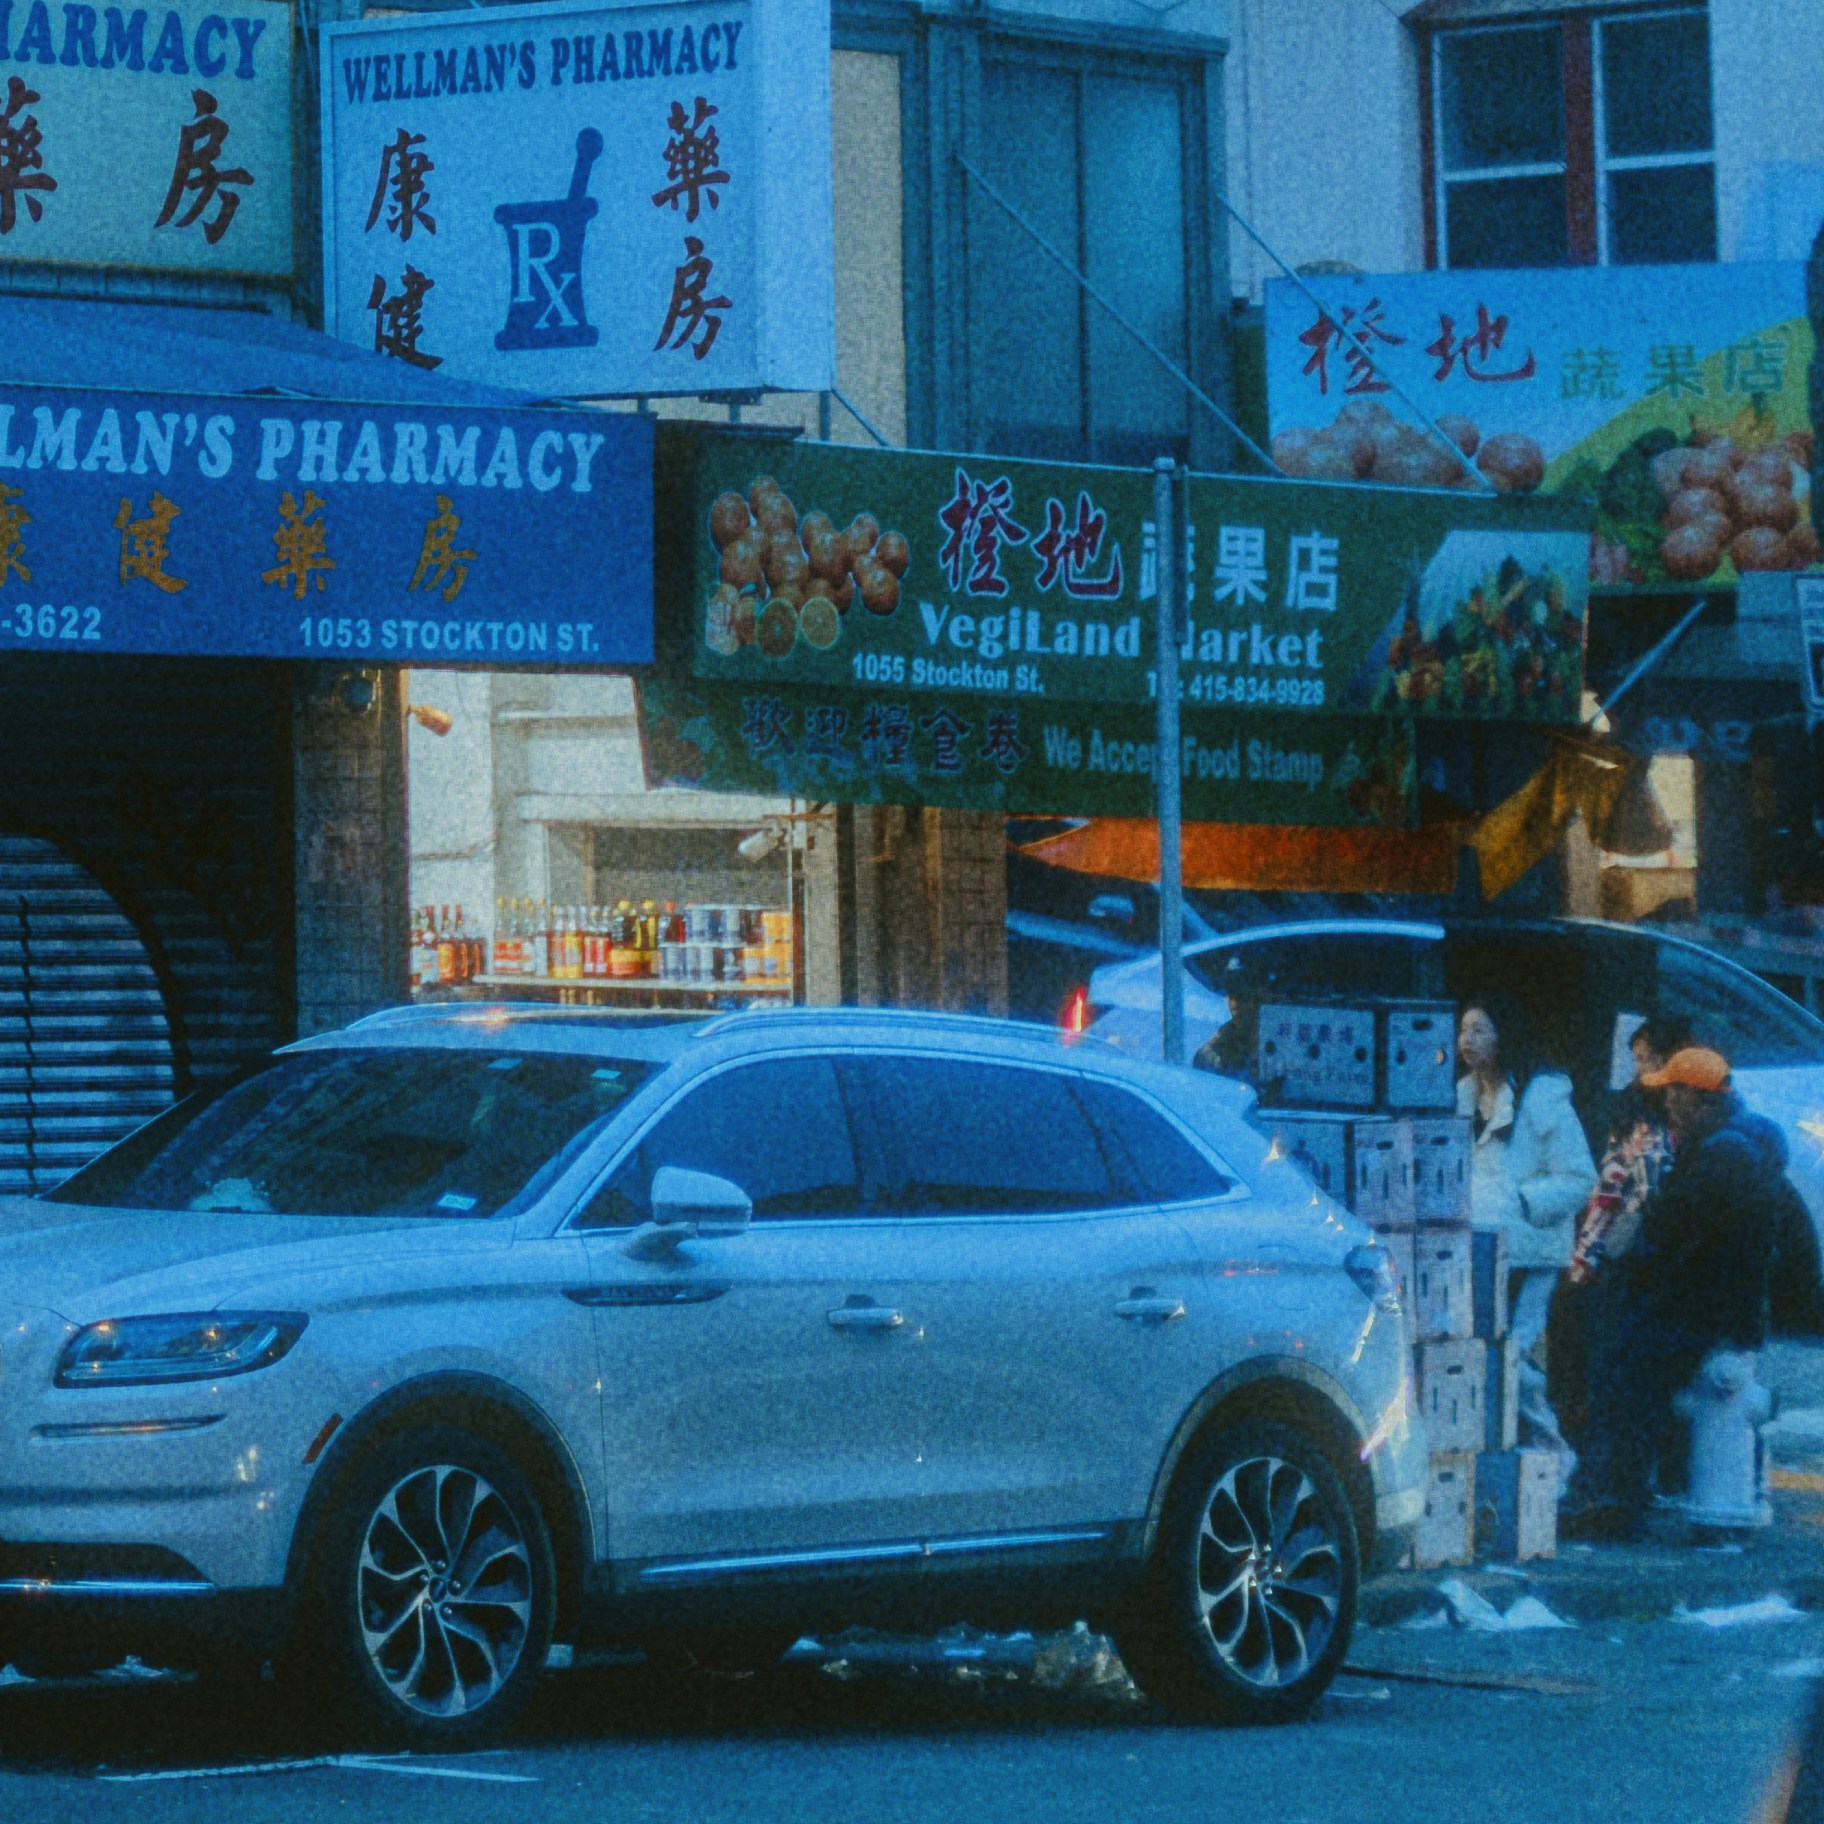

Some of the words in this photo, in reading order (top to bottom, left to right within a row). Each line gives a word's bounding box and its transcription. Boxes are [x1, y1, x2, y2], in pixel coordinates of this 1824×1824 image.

[343, 40, 536, 105] WELLMAN'S
[551, 21, 743, 86] PHARMACY
[255, 418, 605, 493] PHARMACY
[299, 616, 372, 648] 1053
[381, 618, 548, 652] STOCKTON
[556, 622, 600, 652] ST.
[852, 653, 906, 684] 1055
[911, 658, 1009, 691] Stockton
[1015, 669, 1046, 694] St.
[1189, 673, 1325, 706] 415-834-9928
[1043, 725, 1082, 770] We
[1087, 728, 1156, 773] Acce
[1182, 734, 1241, 780] Food
[1247, 739, 1325, 793] Stamp
